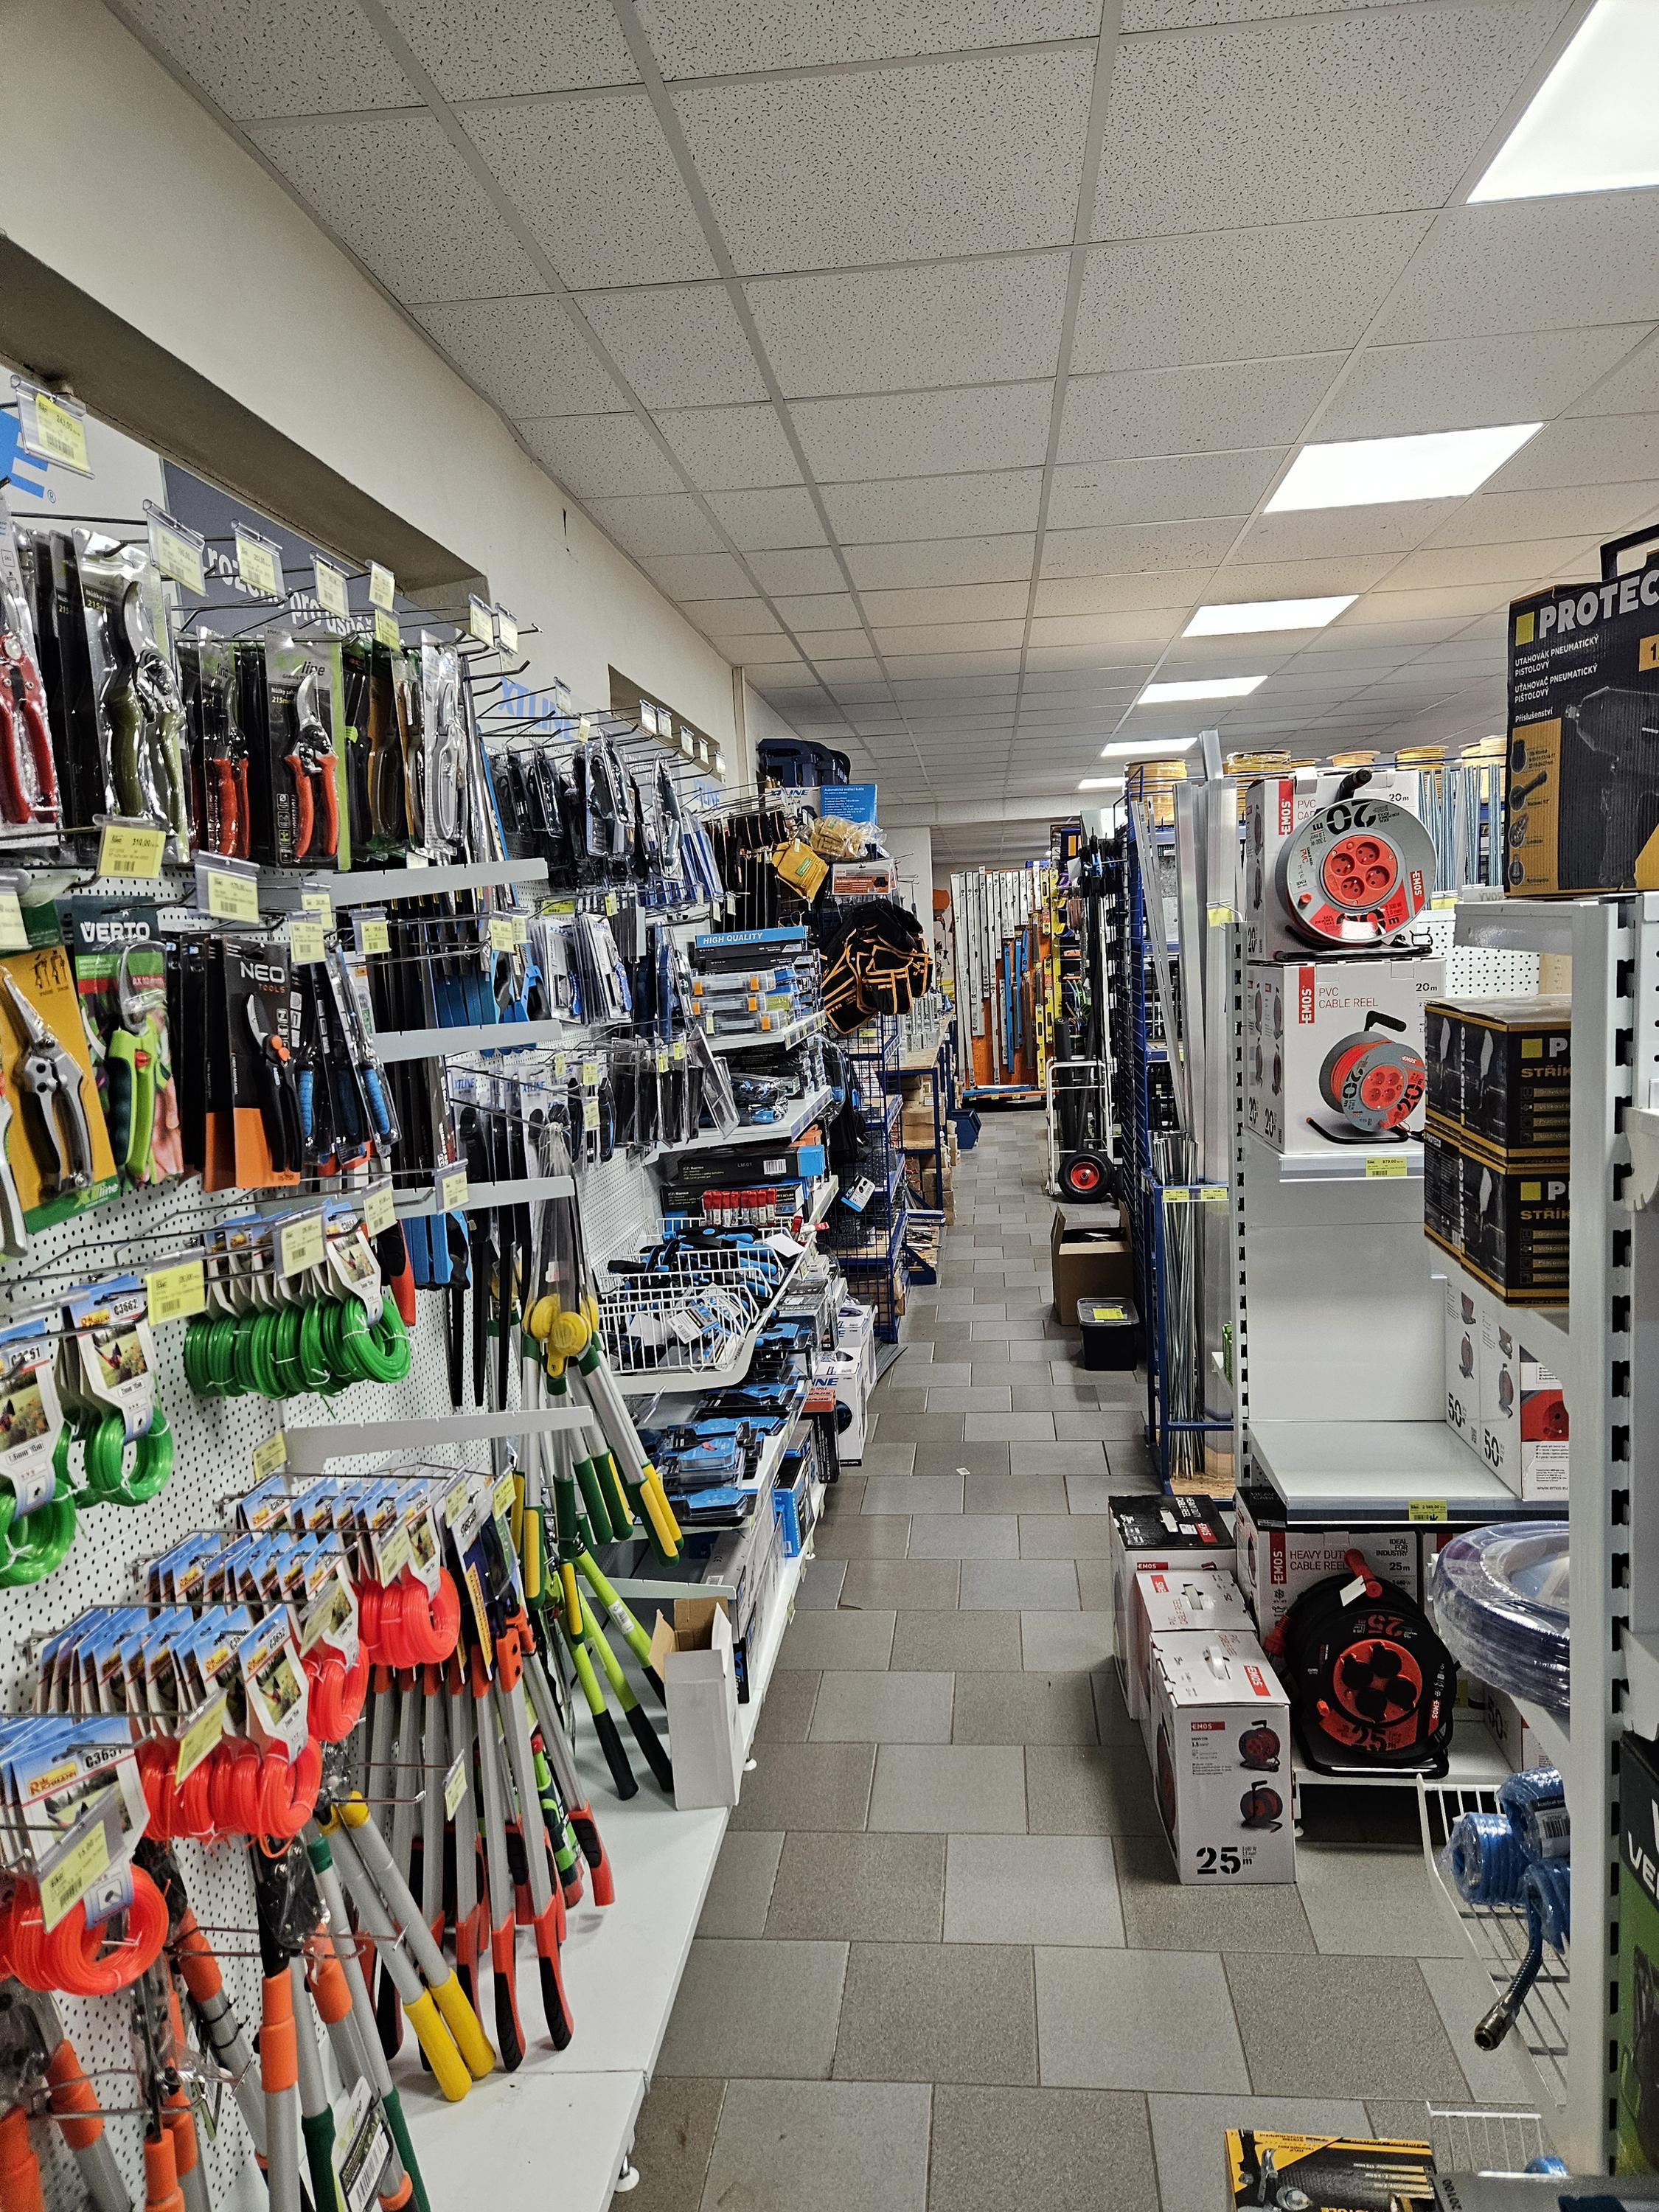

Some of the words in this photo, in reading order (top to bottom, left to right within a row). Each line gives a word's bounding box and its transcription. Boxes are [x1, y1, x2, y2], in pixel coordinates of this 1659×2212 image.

[1539, 569, 1659, 639] PROTEC
[1515, 650, 1550, 667] UTAHOVÁK
[1551, 633, 1599, 657] PNEUMATICKÝ
[1515, 660, 1550, 677] PISTOLOVÝ
[1550, 662, 1598, 684] PNEUMATICKÝ
[271, 686, 286, 695] Nůžky
[1515, 706, 1554, 723] Příslušenství
[1298, 799, 1316, 809] PVC
[1281, 799, 1291, 835] EMOS
[1326, 800, 1377, 835] 20
[1411, 871, 1423, 897] EMOS
[80, 922, 150, 942] VERTO
[703, 936, 724, 945] HIGH
[726, 933, 763, 942] QUALITY
[240, 961, 285, 983] NEO
[259, 984, 286, 993] TOOLS
[1318, 987, 1339, 997] PVC
[1301, 988, 1312, 1023] EMOS
[1318, 999, 1351, 1009] CABLE
[1353, 998, 1378, 1007] REEL
[1402, 1056, 1416, 1064] EMOS
[1548, 1181, 1570, 1201] P
[1448, 1391, 1461, 1428] 50
[1484, 1428, 1500, 1467] 50
[1197, 1523, 1211, 1537] EMOS
[1290, 1551, 1321, 1559] HEAVY
[1273, 1551, 1284, 1585] EMOS
[1290, 1562, 1321, 1571] CABLE
[1324, 1561, 1348, 1571] REEL
[1367, 1614, 1404, 1637] 25
[1247, 1666, 1264, 1687] EMOS
[1432, 1700, 1440, 1719] EMOS
[1196, 1847, 1241, 1875] 25
[1627, 1829, 1659, 1902] VE
